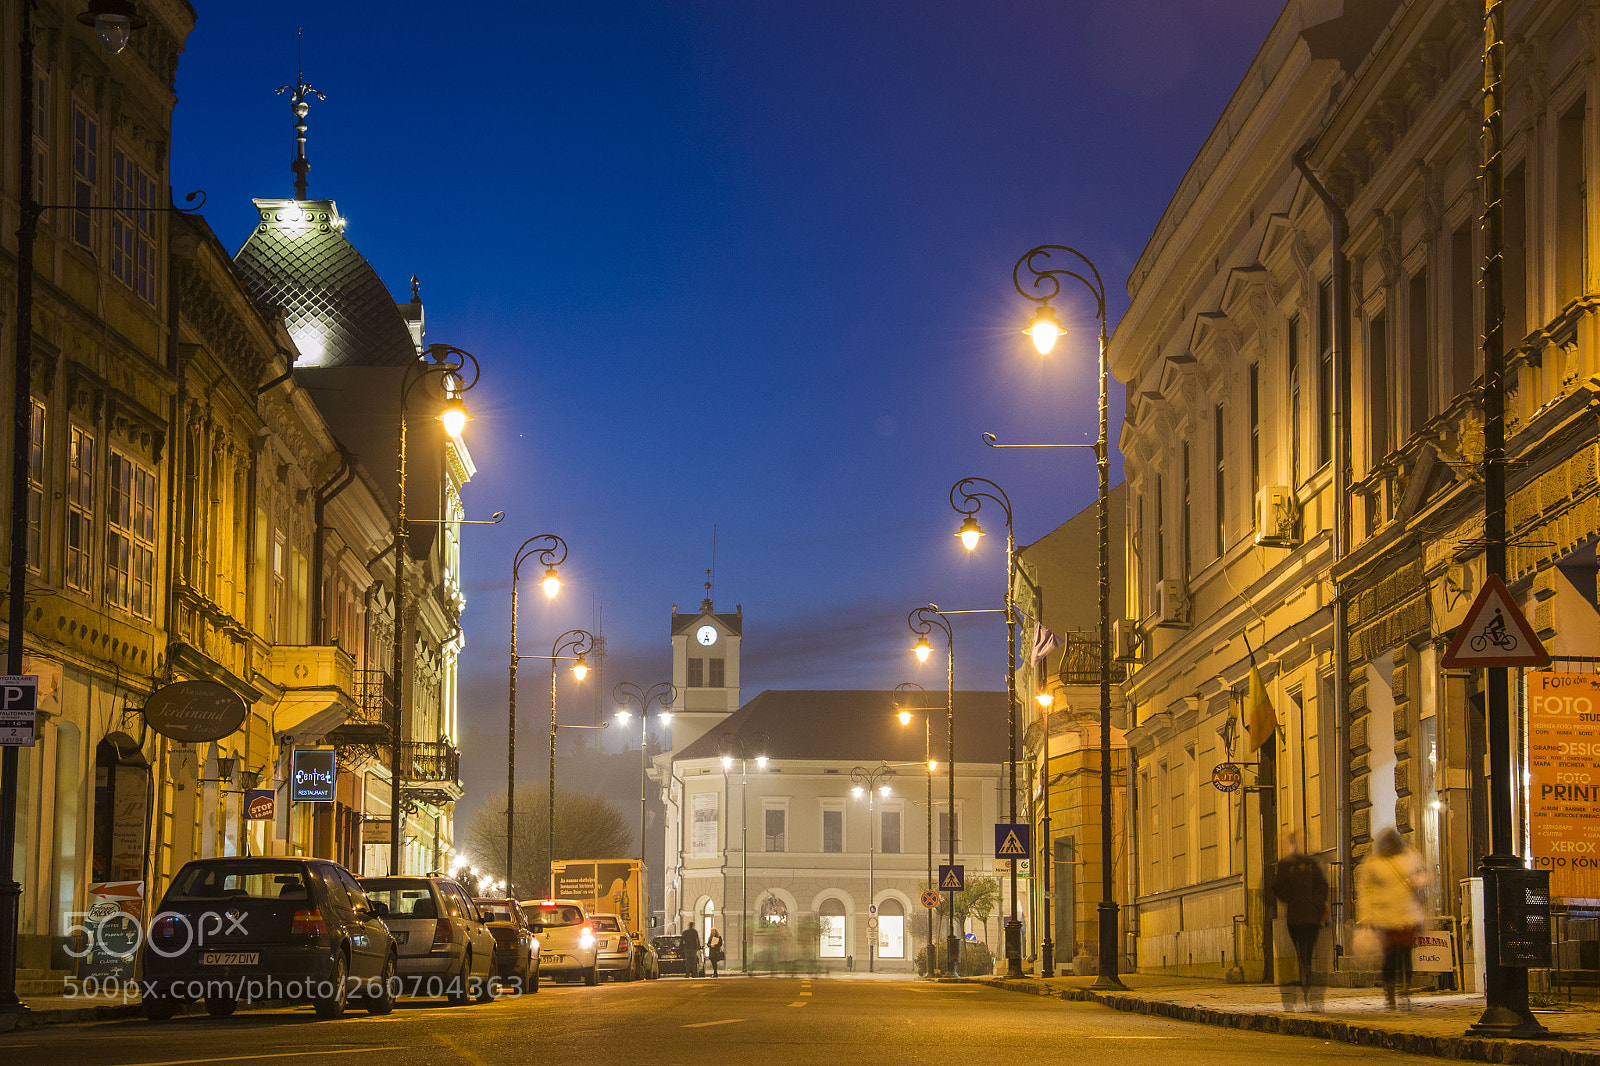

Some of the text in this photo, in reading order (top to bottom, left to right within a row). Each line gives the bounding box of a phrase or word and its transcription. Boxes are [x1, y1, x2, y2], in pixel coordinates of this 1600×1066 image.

[1542, 677, 1572, 690] FOTO
[3, 687, 23, 710] P
[1533, 696, 1592, 714] FOTO
[154, 698, 236, 721] Ferdinand
[11, 728, 17, 736] 2
[1556, 772, 1591, 784] FOTO
[1542, 784, 1600, 802] PRINT
[251, 802, 273, 814] STOP
[1550, 840, 1596, 853] XEROX
[1534, 856, 1566, 872] FOTO
[206, 954, 256, 964] CV 77 DIV
